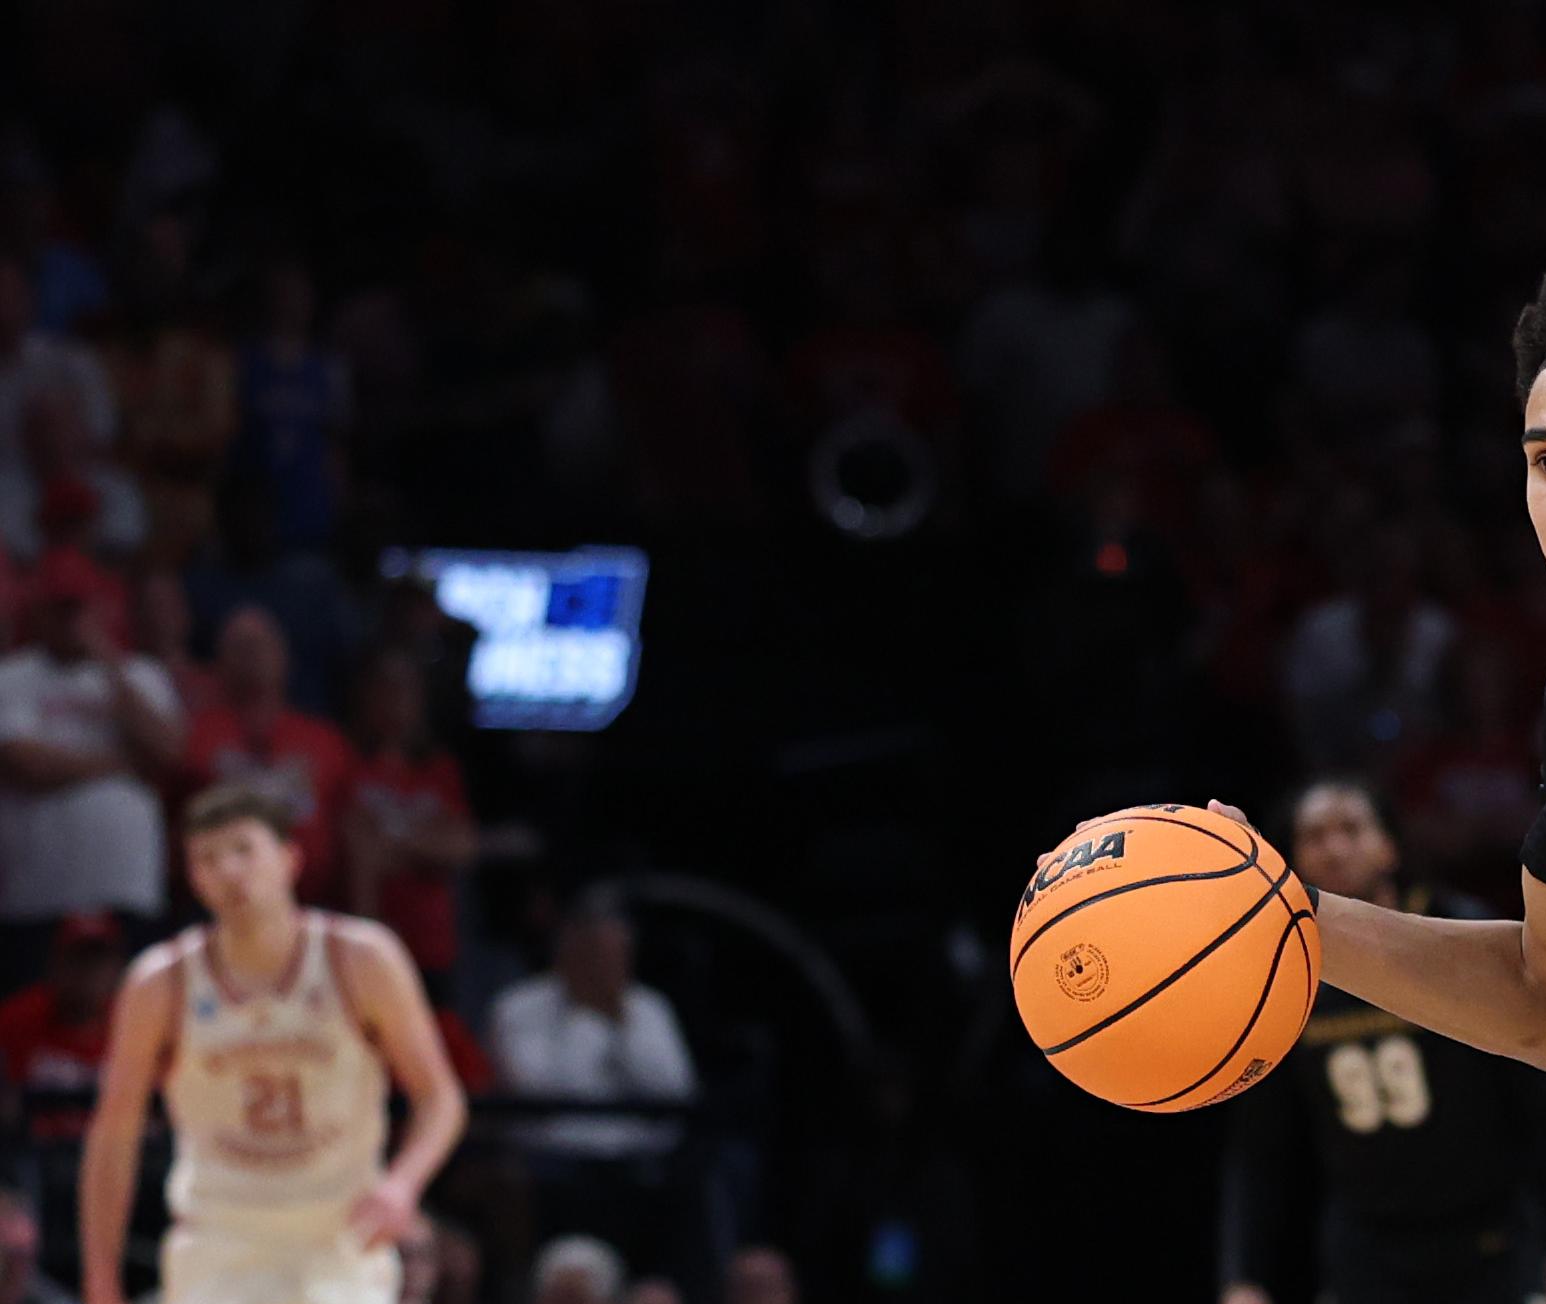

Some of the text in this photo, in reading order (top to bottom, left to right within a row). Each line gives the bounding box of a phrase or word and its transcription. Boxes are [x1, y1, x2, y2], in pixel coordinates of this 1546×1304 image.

[1018, 831, 1126, 922] NCAA
[1087, 863, 1122, 875] BALL
[1326, 1036, 1430, 1133] 99
